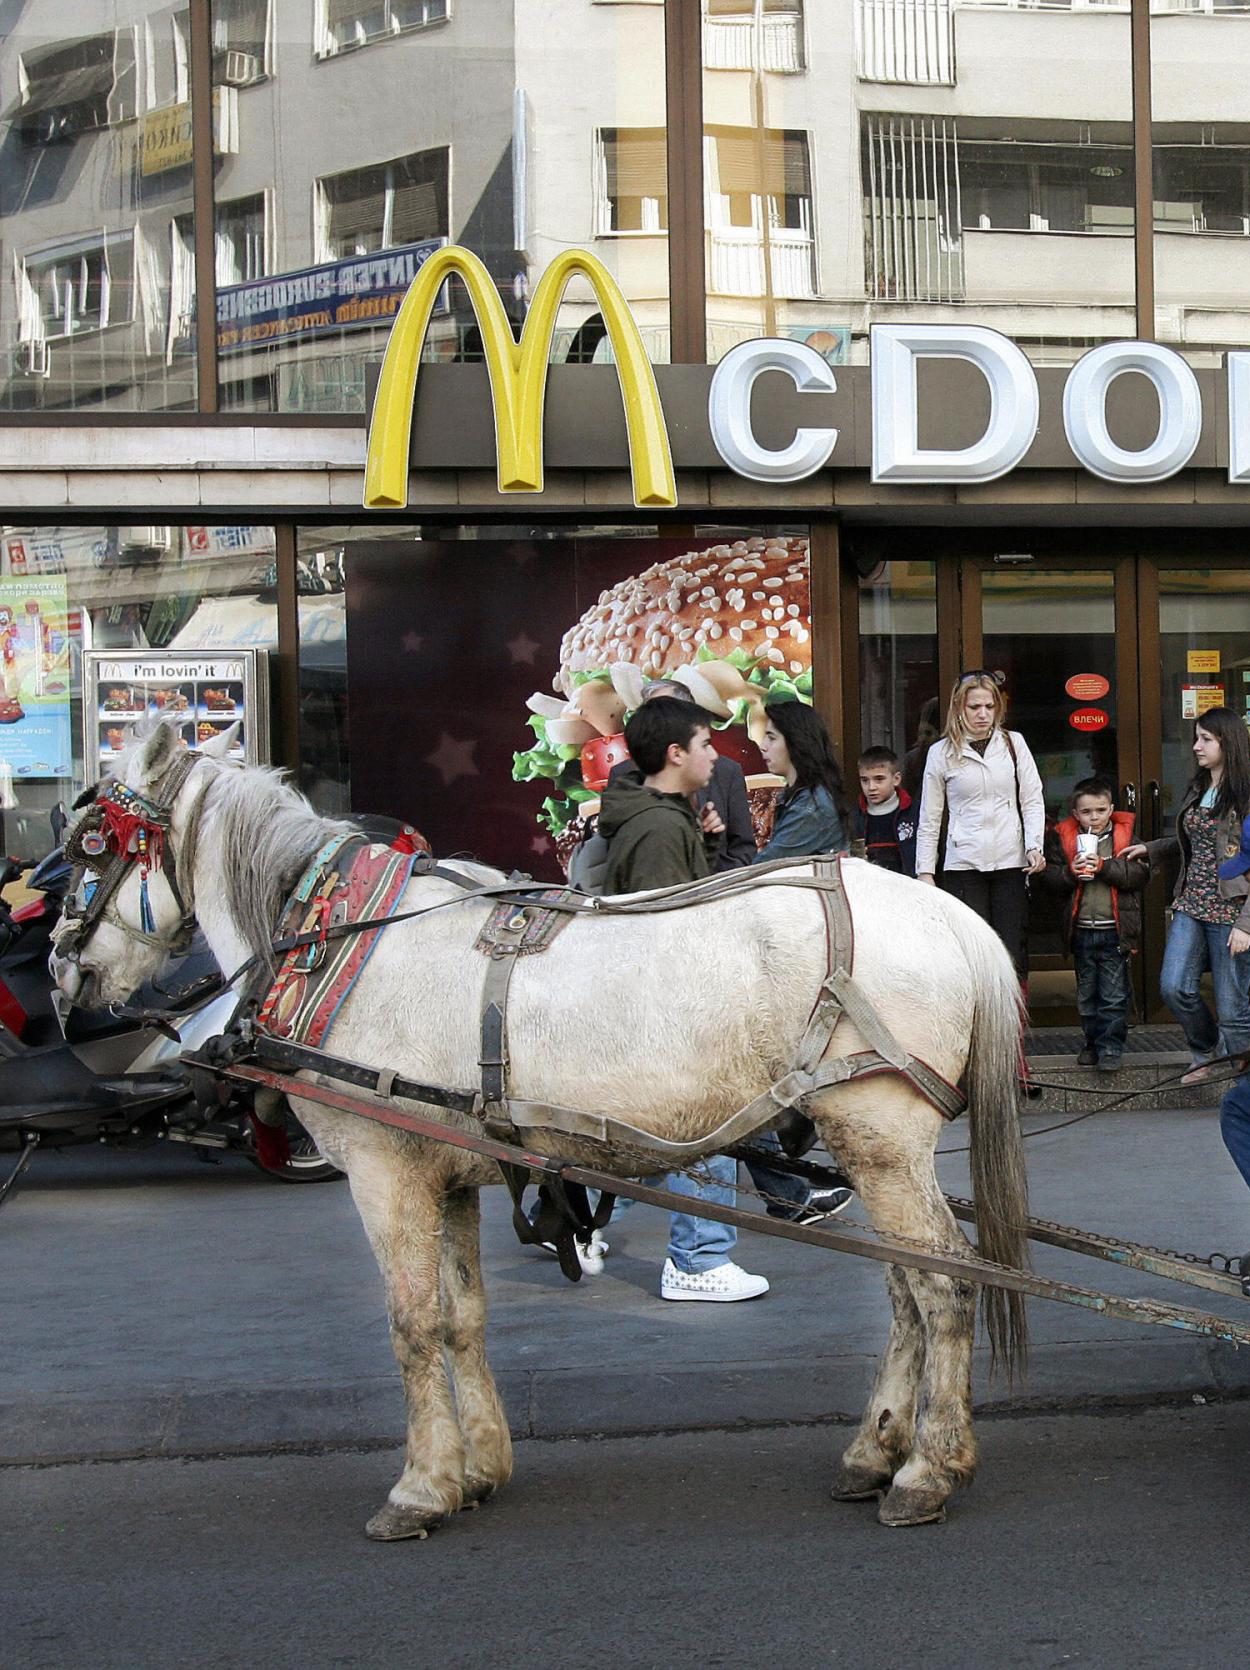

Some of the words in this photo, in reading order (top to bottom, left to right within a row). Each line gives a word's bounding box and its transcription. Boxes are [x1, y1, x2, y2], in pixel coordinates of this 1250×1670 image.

[134, 664, 156, 677] i'm
[161, 664, 202, 677] lovin'
[205, 664, 216, 677] it
[1073, 715, 1105, 724] ВЛЕЧИ
